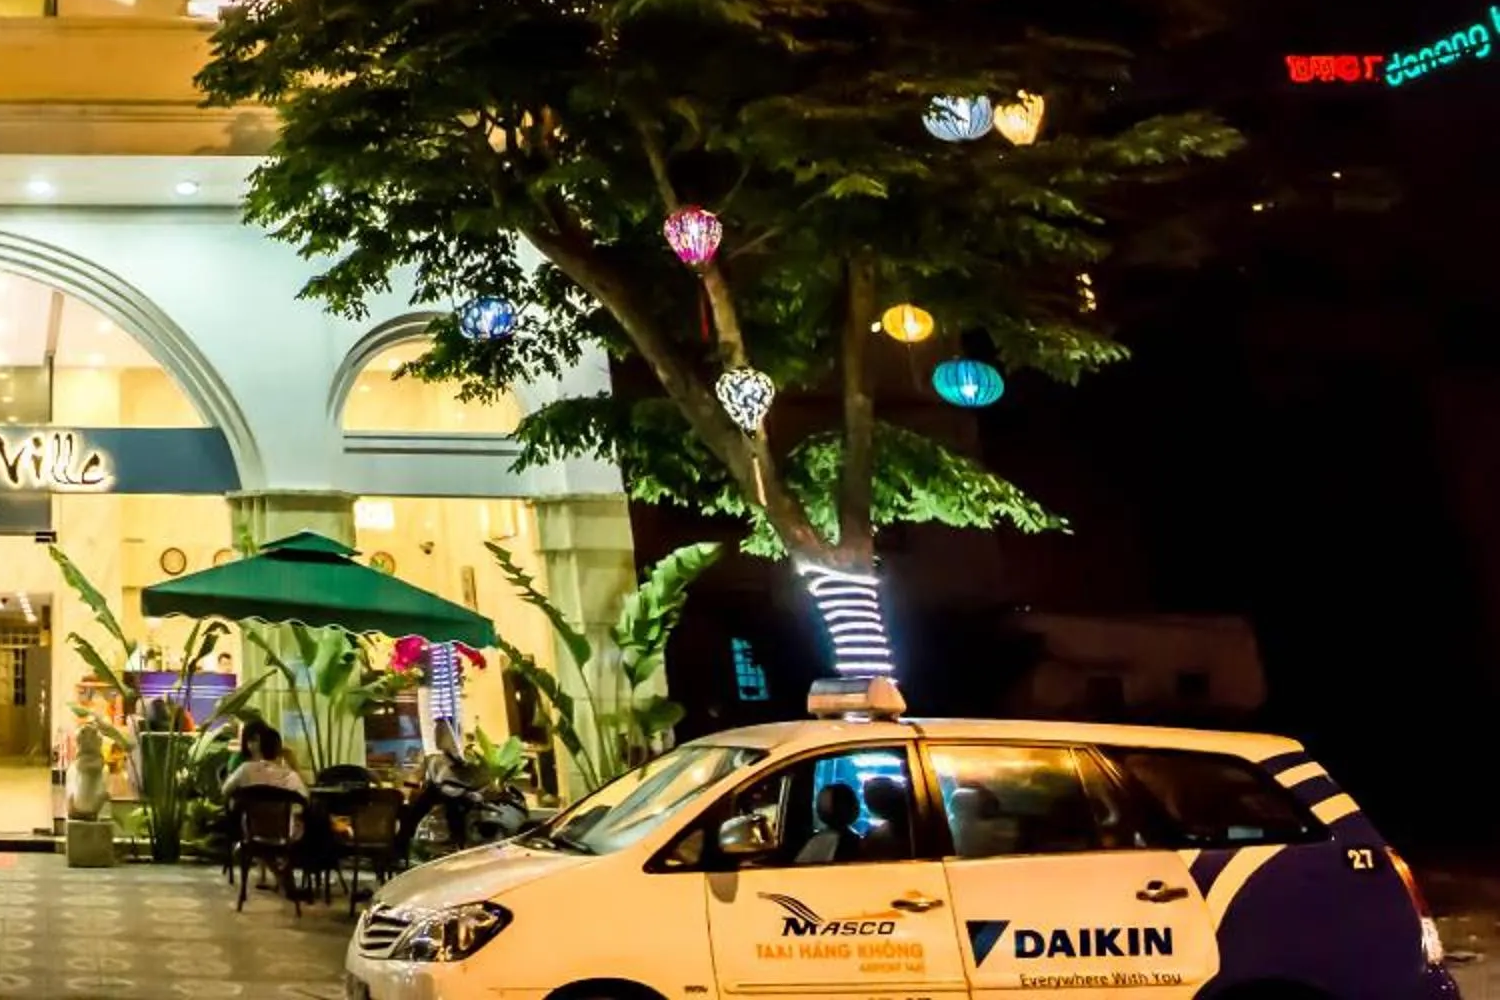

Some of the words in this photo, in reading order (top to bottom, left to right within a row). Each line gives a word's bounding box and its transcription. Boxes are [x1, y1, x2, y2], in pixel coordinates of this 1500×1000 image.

[1347, 849, 1374, 869] 27
[782, 916, 895, 936] MASCO
[1014, 928, 1173, 959] DAIKIN
[1019, 973, 1109, 988] Everywhere
[1112, 972, 1148, 986] With
[1152, 971, 1183, 985] You
